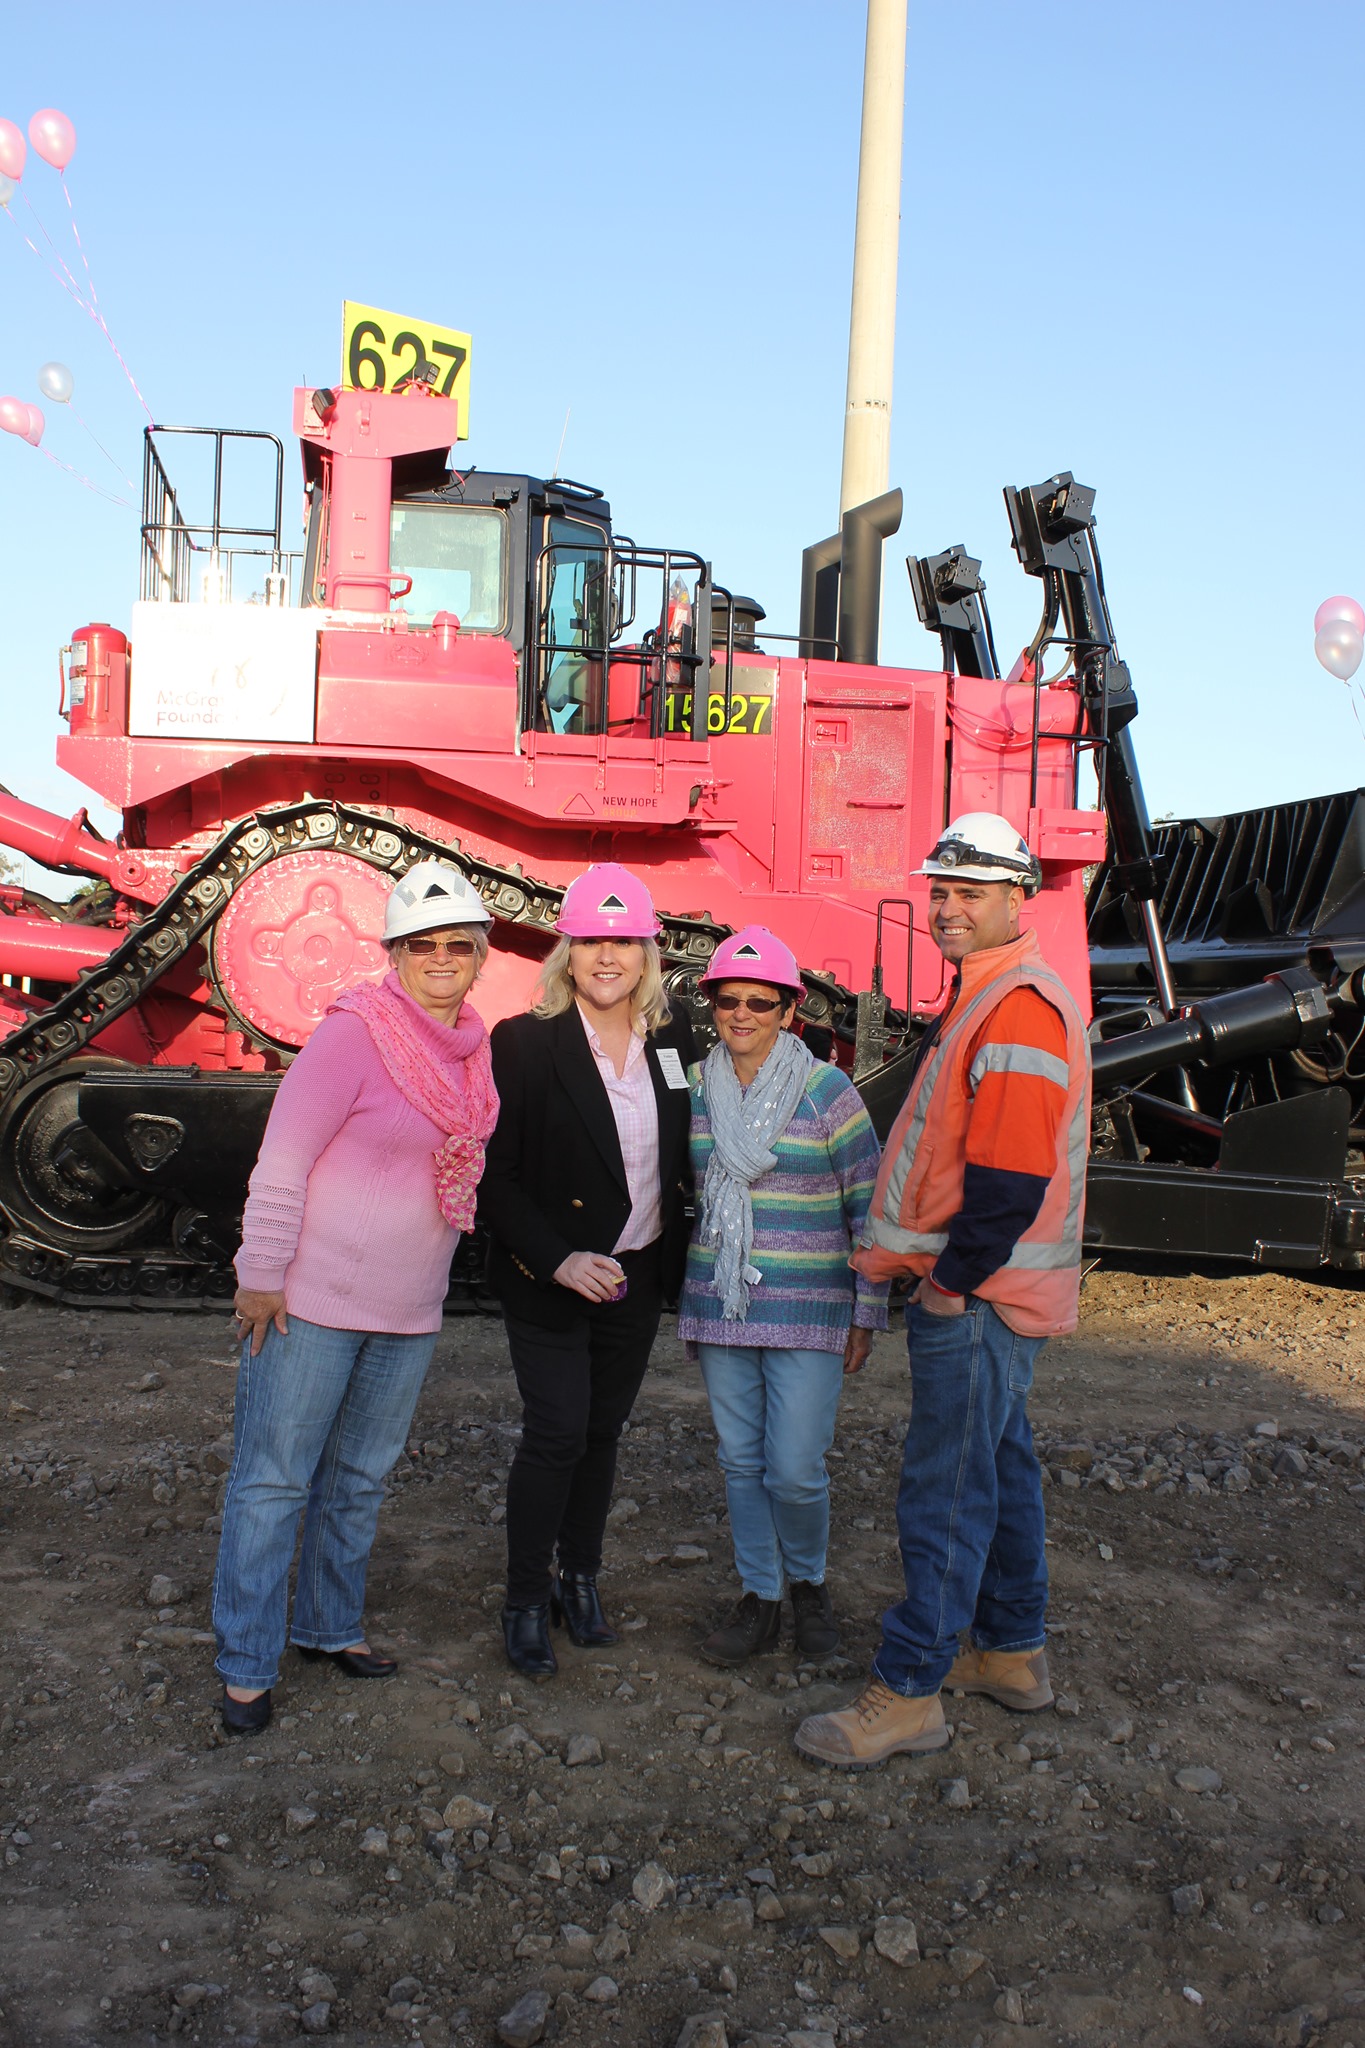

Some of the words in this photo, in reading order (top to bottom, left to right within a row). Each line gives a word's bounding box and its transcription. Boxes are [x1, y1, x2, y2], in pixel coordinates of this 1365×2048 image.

[348, 320, 467, 398] 627
[157, 689, 223, 708] McGra
[156, 710, 230, 727] Founda
[665, 693, 772, 734] 15627
[602, 796, 627, 806] NEW
[630, 797, 658, 807] HOPE
[602, 807, 637, 817] GROUP
